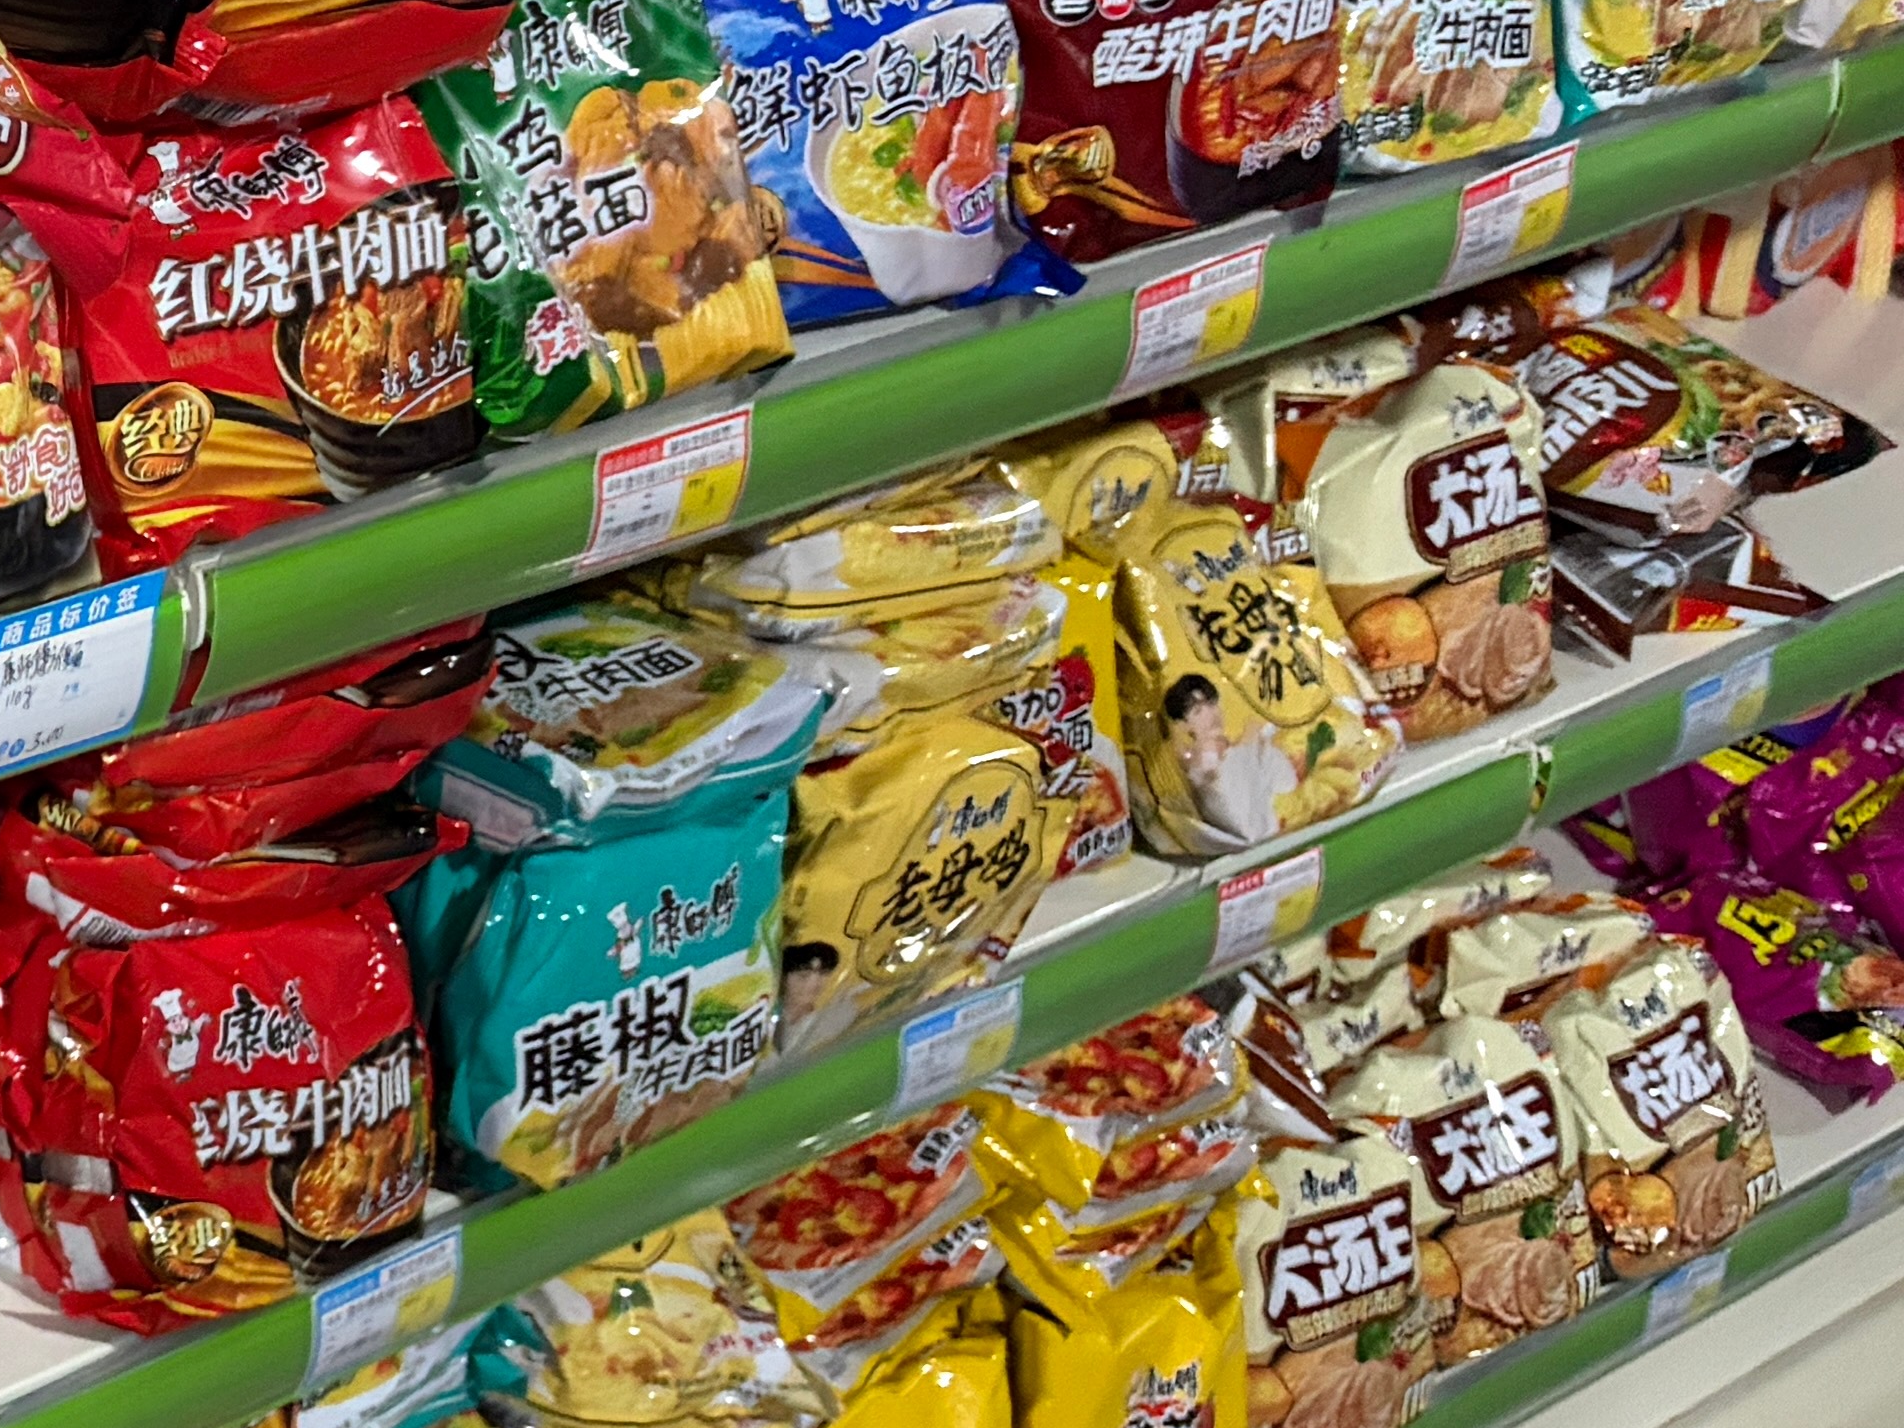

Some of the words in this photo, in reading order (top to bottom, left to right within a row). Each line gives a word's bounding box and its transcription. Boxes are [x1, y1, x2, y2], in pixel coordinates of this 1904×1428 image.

[1430, 4, 1534, 71] 牛肉面
[725, 19, 1014, 152] 鲜虾鱼板面
[190, 137, 330, 221] 康師傅
[148, 199, 450, 341] 红烧牛肉面
[0, 583, 141, 649] 商品标价签
[534, 635, 702, 705] 牛肉面
[883, 837, 1033, 931] 老母鸡
[515, 969, 696, 1116] 藤椒
[630, 998, 771, 1104] 牛肉面
